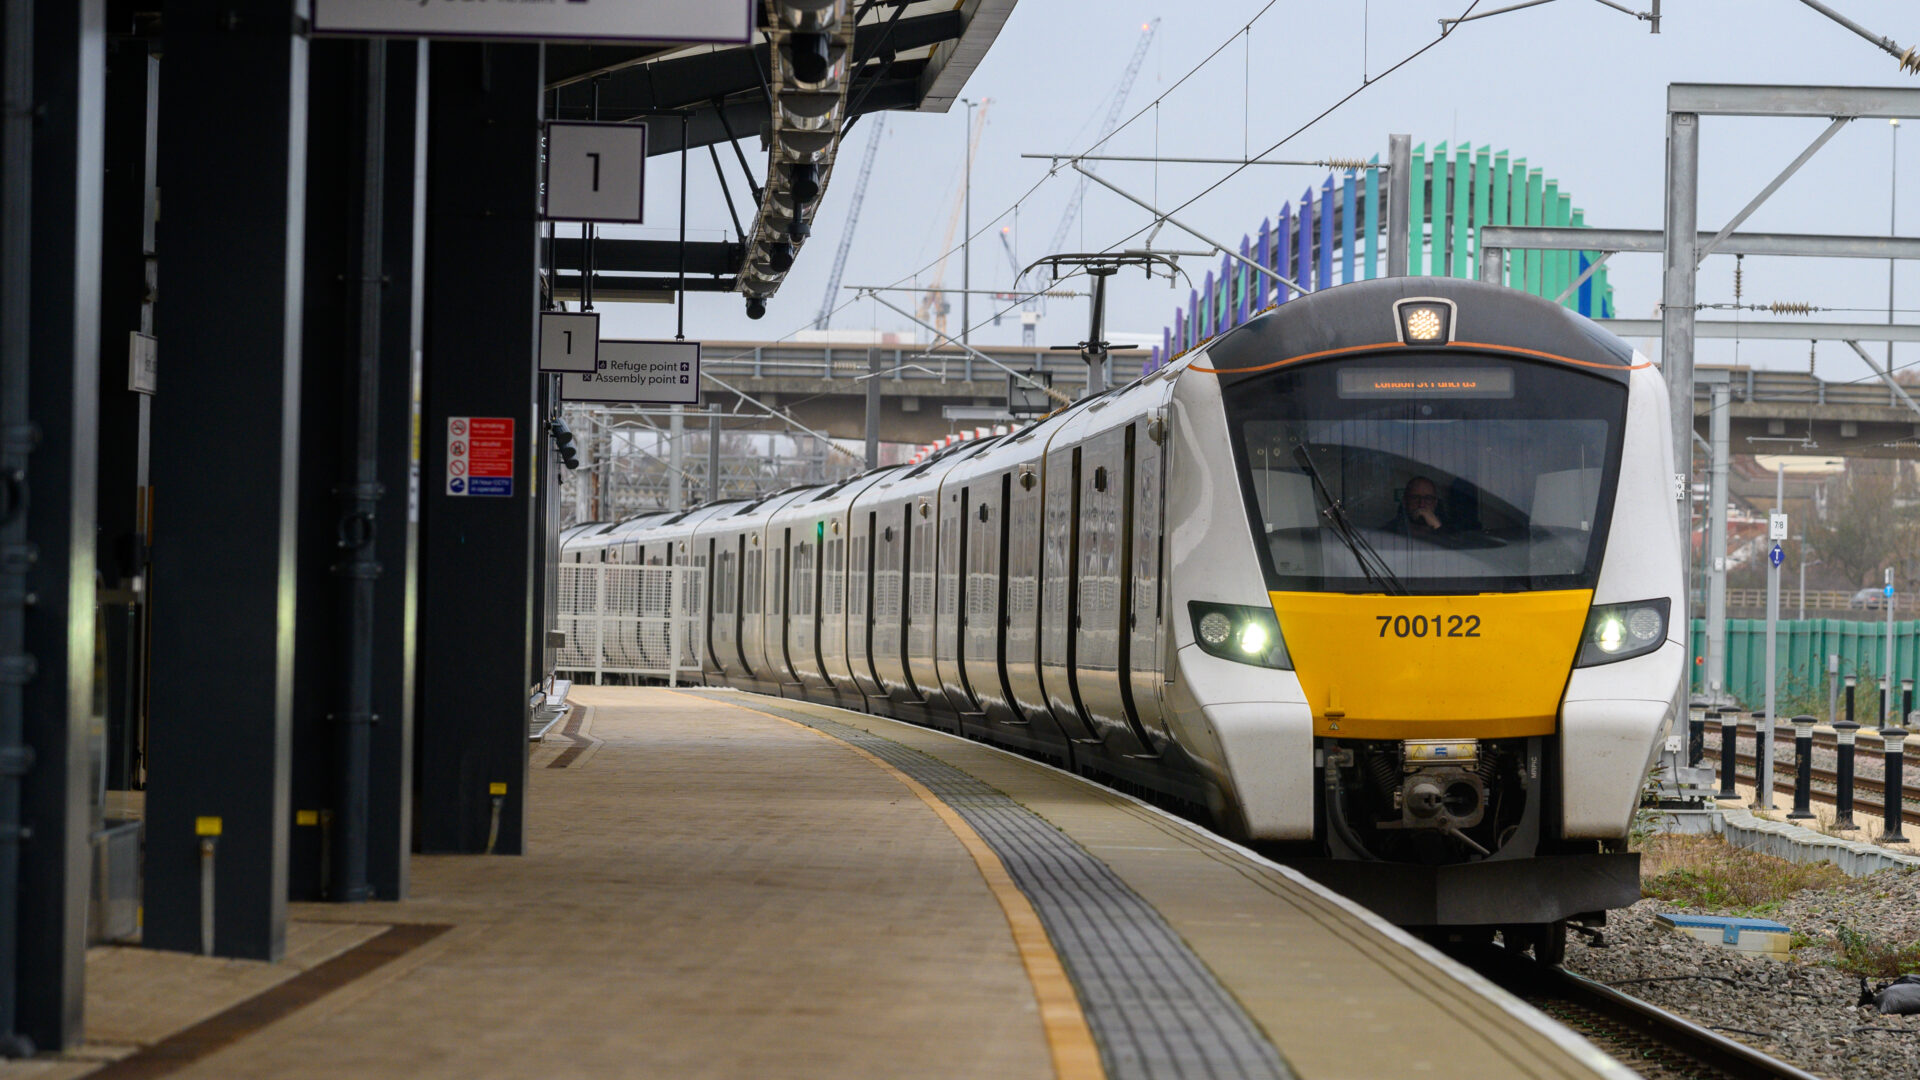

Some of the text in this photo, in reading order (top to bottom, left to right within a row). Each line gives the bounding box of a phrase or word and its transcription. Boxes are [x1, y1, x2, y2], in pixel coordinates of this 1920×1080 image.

[586, 152, 600, 192] 1
[563, 331, 572, 355] 1
[595, 373, 677, 385] Assembly point
[610, 360, 678, 374] Refuge point
[1376, 614, 1481, 638] 700122
